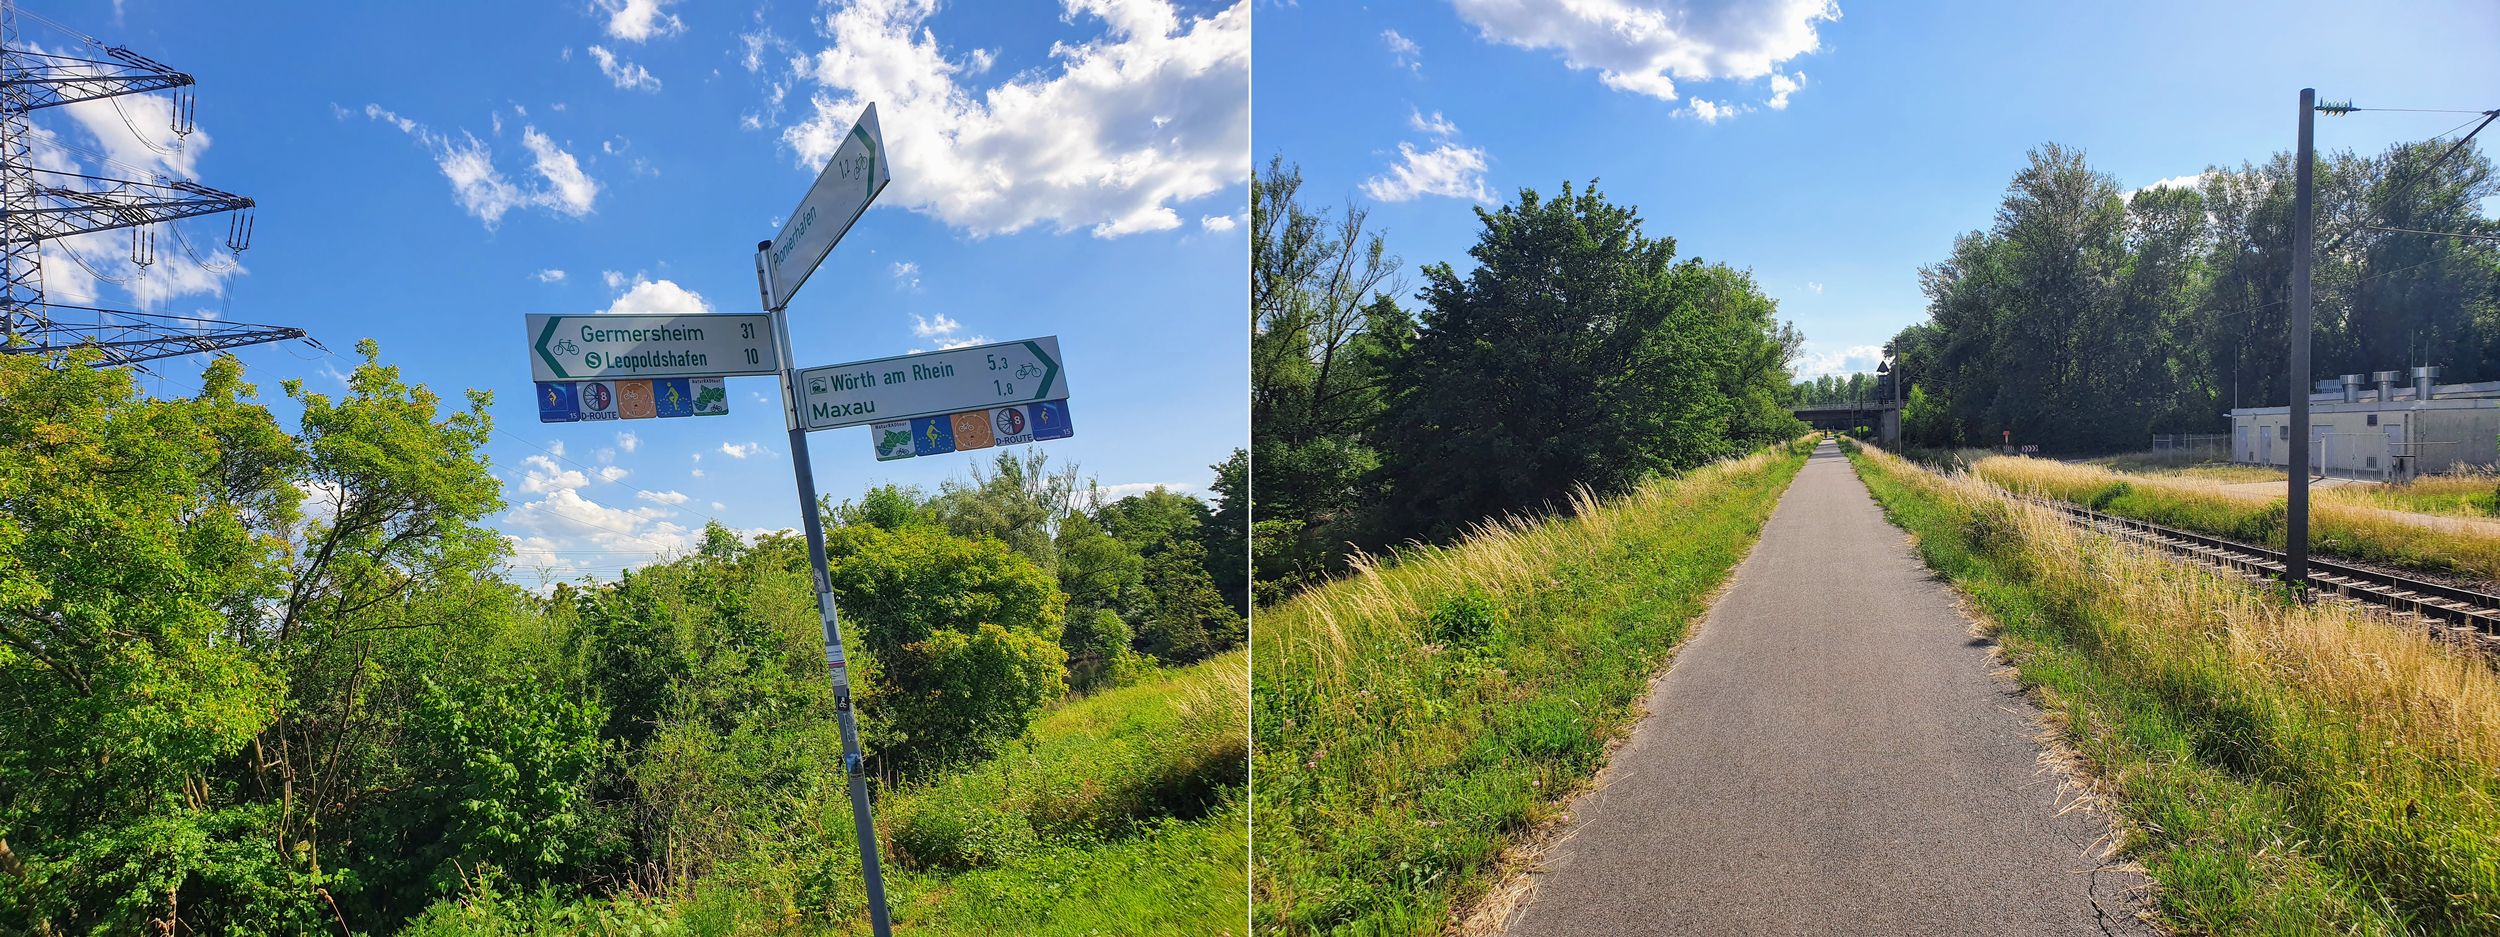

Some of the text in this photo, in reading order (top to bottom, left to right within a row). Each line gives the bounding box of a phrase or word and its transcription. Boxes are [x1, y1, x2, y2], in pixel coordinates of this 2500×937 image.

[773, 206, 817, 271] Pionierhafen
[581, 322, 755, 343] Germersheim 31
[586, 347, 759, 372] S Leopoldshafen 10
[830, 371, 876, 392] Wörth
[883, 369, 906, 385] am
[912, 361, 955, 382] Rhein
[600, 391, 607, 401] 8
[581, 411, 617, 420] D-ROUTE
[812, 399, 875, 420] Maxau
[1013, 416, 1021, 425] 8
[996, 433, 1033, 445] D-ROUTE
